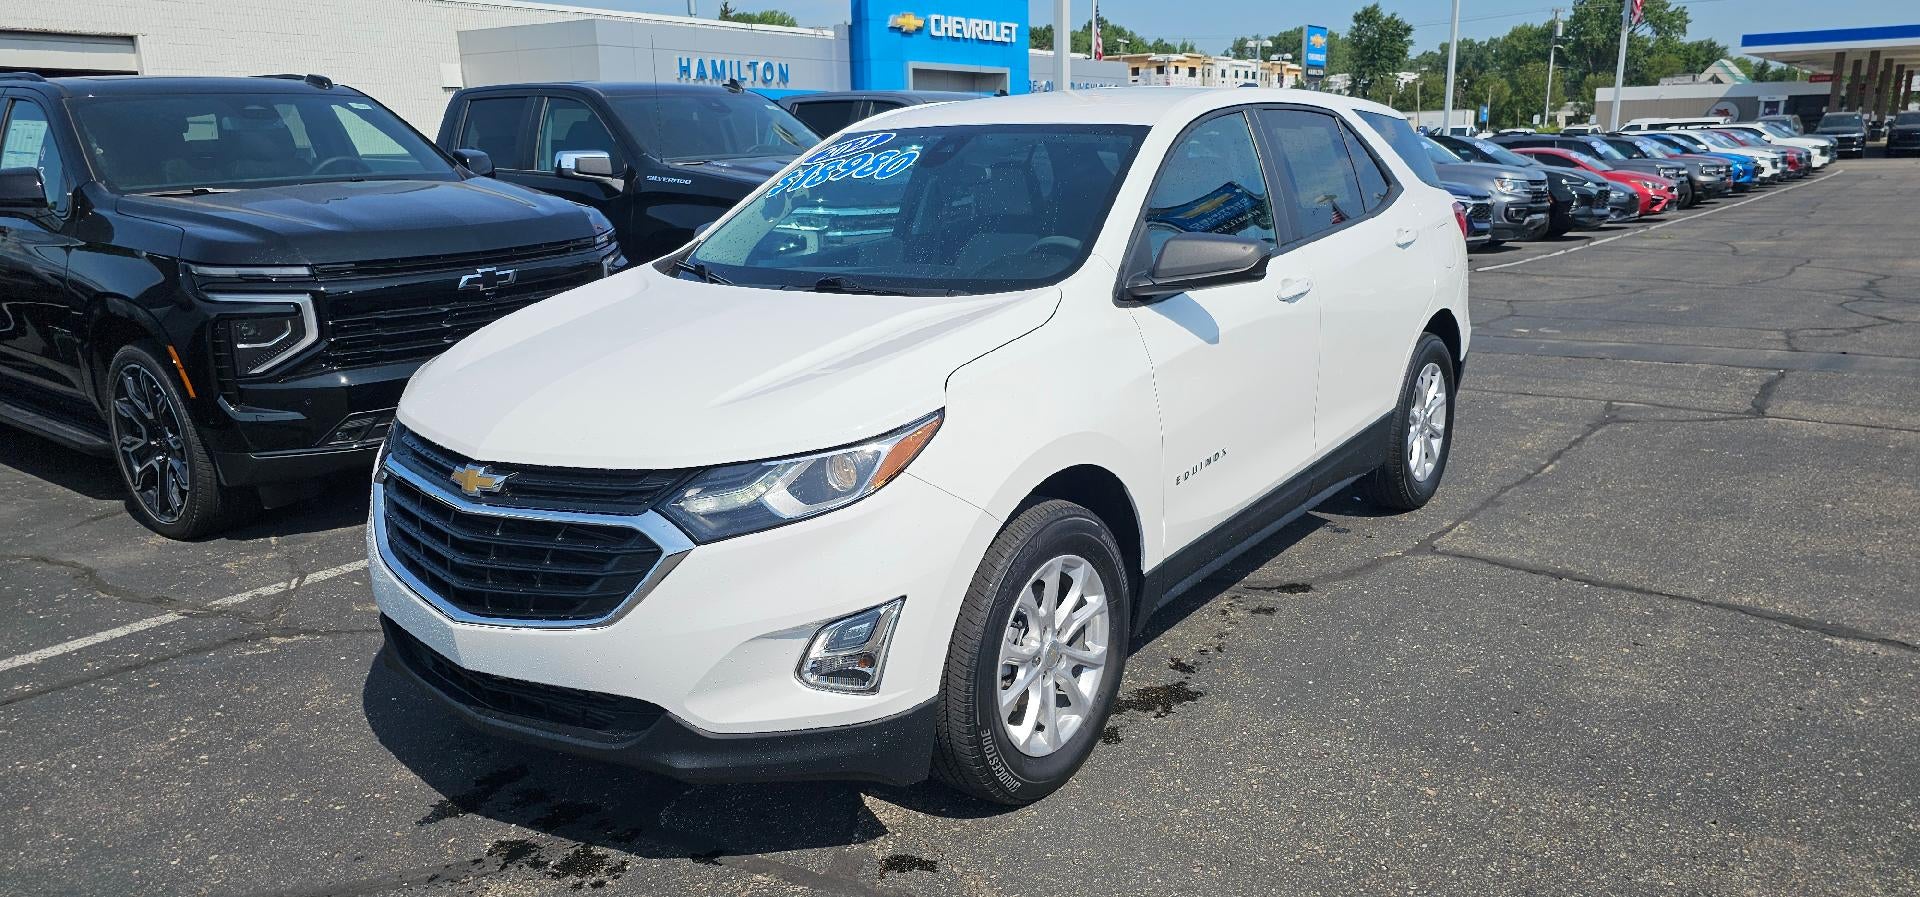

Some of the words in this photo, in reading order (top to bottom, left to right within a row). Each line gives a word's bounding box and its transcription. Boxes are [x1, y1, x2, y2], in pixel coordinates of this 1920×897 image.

[930, 14, 1018, 43] CHEVROLET
[678, 57, 790, 84] HAMILTON
[646, 175, 692, 185] SILVERADO
[766, 150, 919, 198] $18980
[1175, 448, 1227, 486] EQUINOX
[980, 728, 1022, 793] BRIDGESTONE
